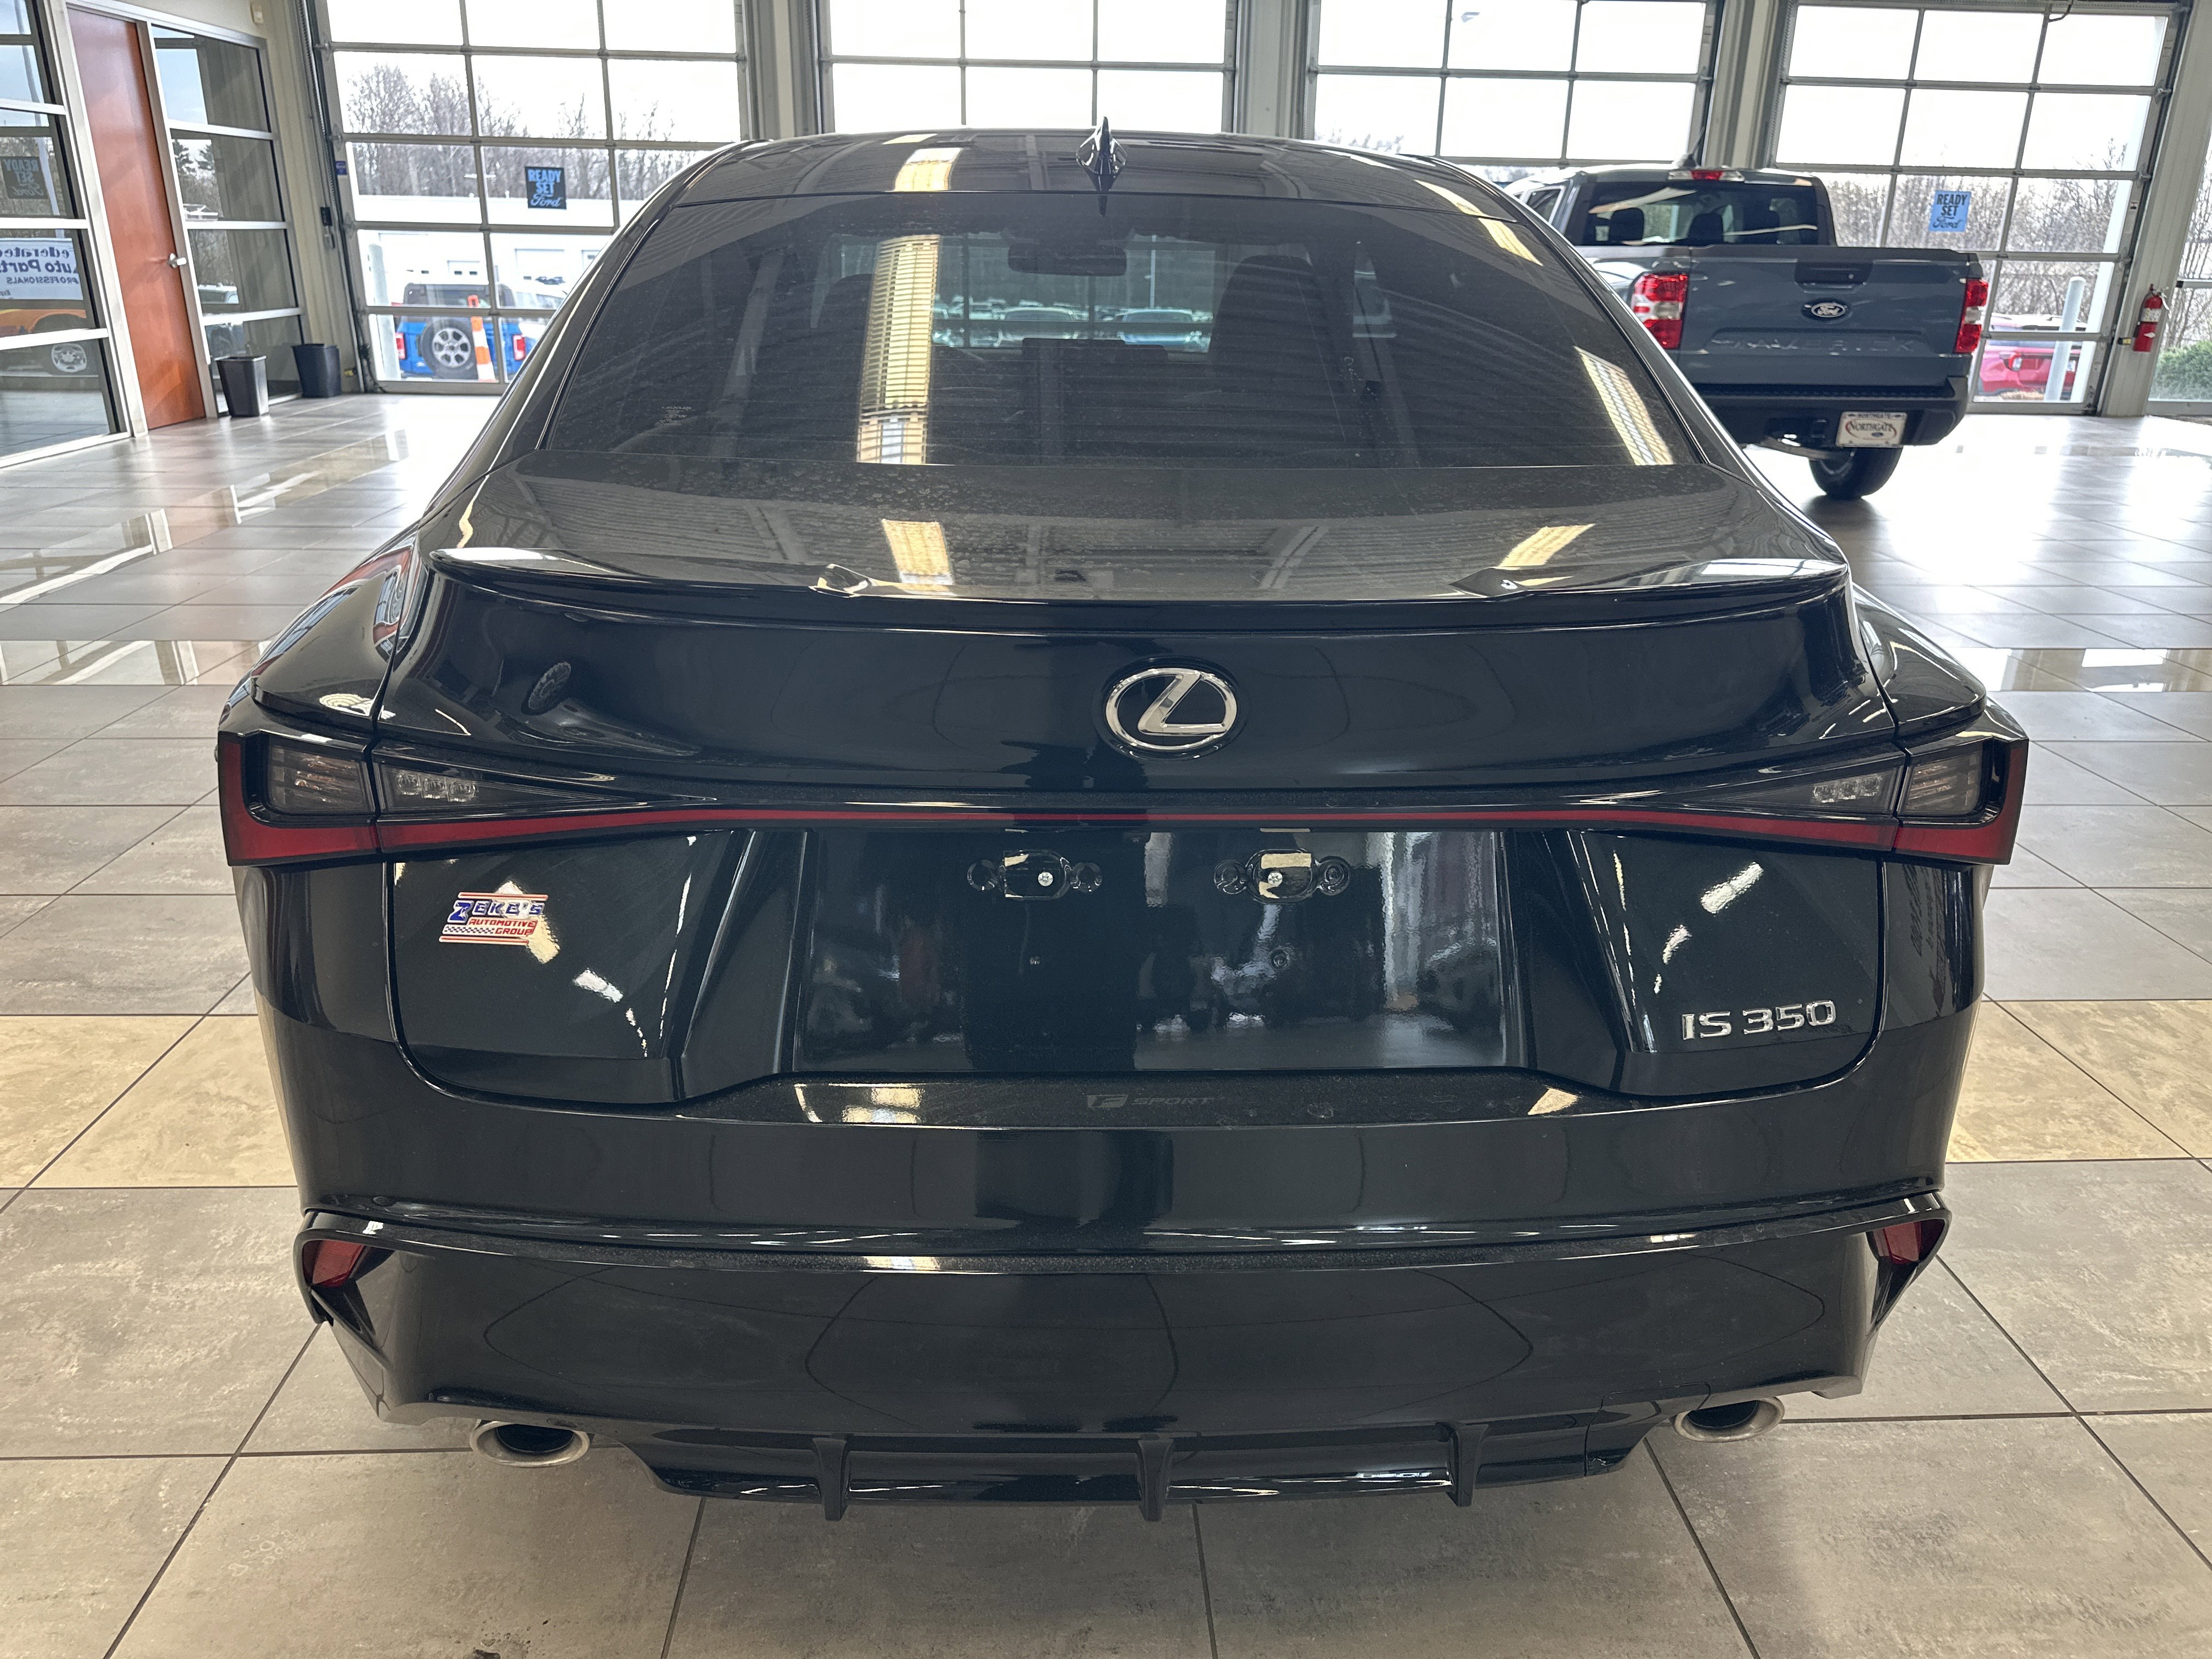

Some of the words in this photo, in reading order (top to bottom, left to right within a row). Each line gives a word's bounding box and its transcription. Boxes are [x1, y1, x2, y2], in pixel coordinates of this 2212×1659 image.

[528, 169, 562, 183] READY
[535, 182, 554, 194] SET
[530, 193, 562, 207] Ford
[1937, 194, 1967, 205] READY
[1941, 205, 1959, 216] SET
[1933, 216, 1962, 228] Ford
[447, 900, 545, 923] ZEKE'S
[469, 918, 537, 927] AUTOMOTIVE
[1682, 1011, 1731, 1040] IS
[1742, 999, 1836, 1035] 350
[1132, 1097, 1214, 1105] SPORT
